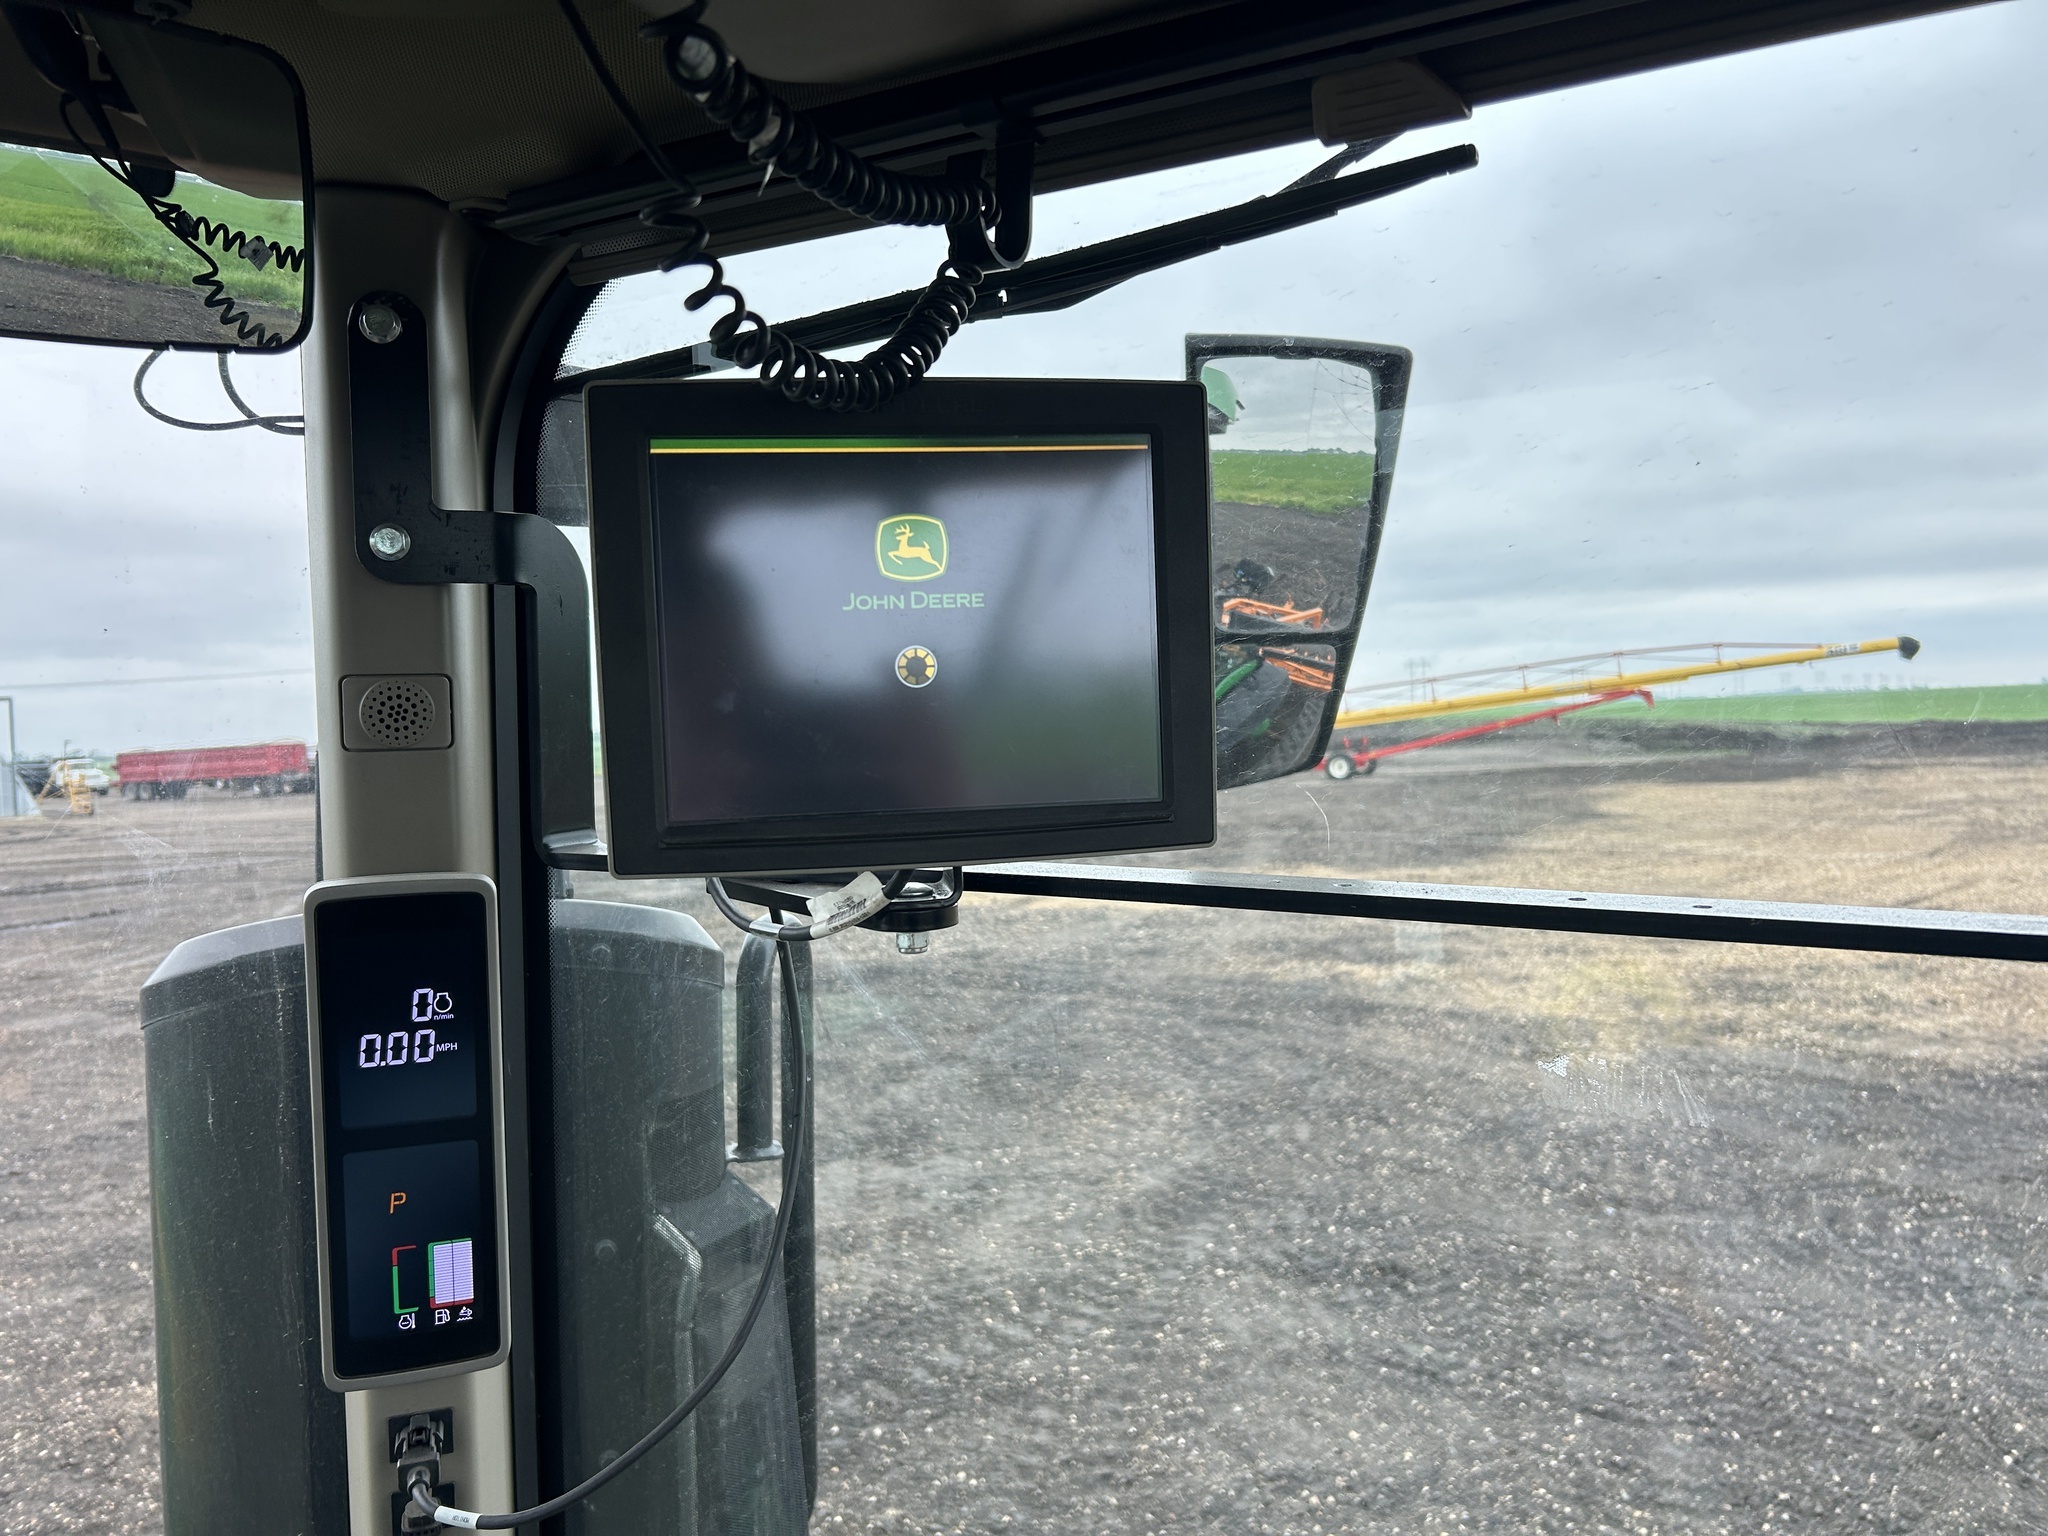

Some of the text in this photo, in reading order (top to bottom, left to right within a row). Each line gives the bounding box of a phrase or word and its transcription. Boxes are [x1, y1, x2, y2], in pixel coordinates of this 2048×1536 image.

[842, 591, 985, 611] JOHN DEERE
[412, 988, 454, 1022] 0 n/min
[359, 1029, 458, 1068] 0.00 MPH
[389, 1192, 407, 1214] P
